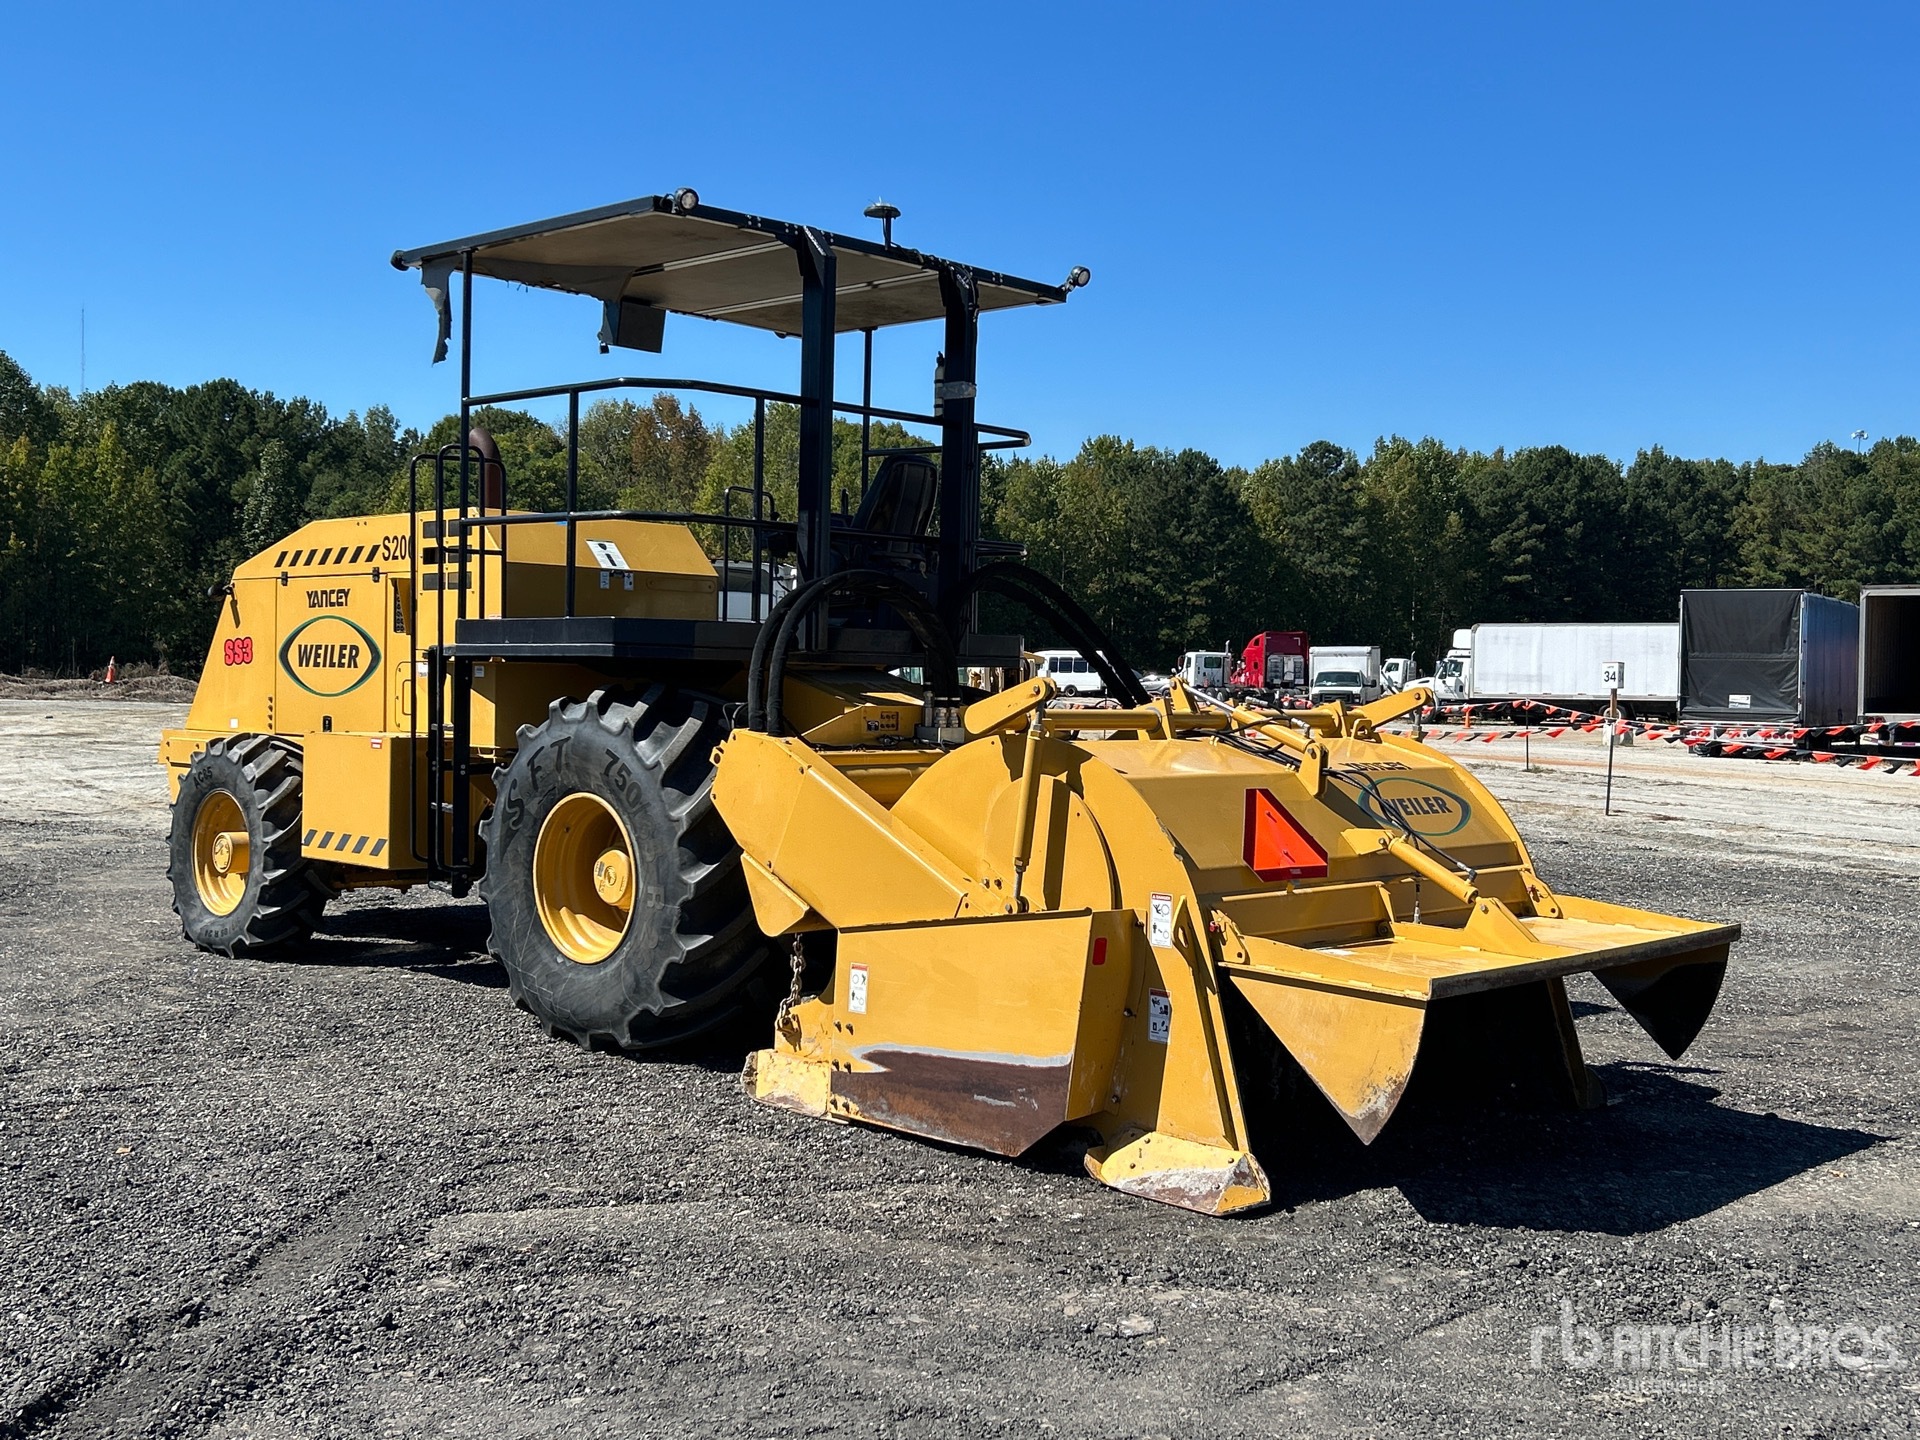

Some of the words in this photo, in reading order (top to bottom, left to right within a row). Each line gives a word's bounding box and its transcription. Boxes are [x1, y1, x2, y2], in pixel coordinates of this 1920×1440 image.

[306, 588, 351, 608] YANCEY
[224, 636, 253, 666] SS3
[298, 644, 360, 668] WEILER
[1603, 670, 1616, 682] 34
